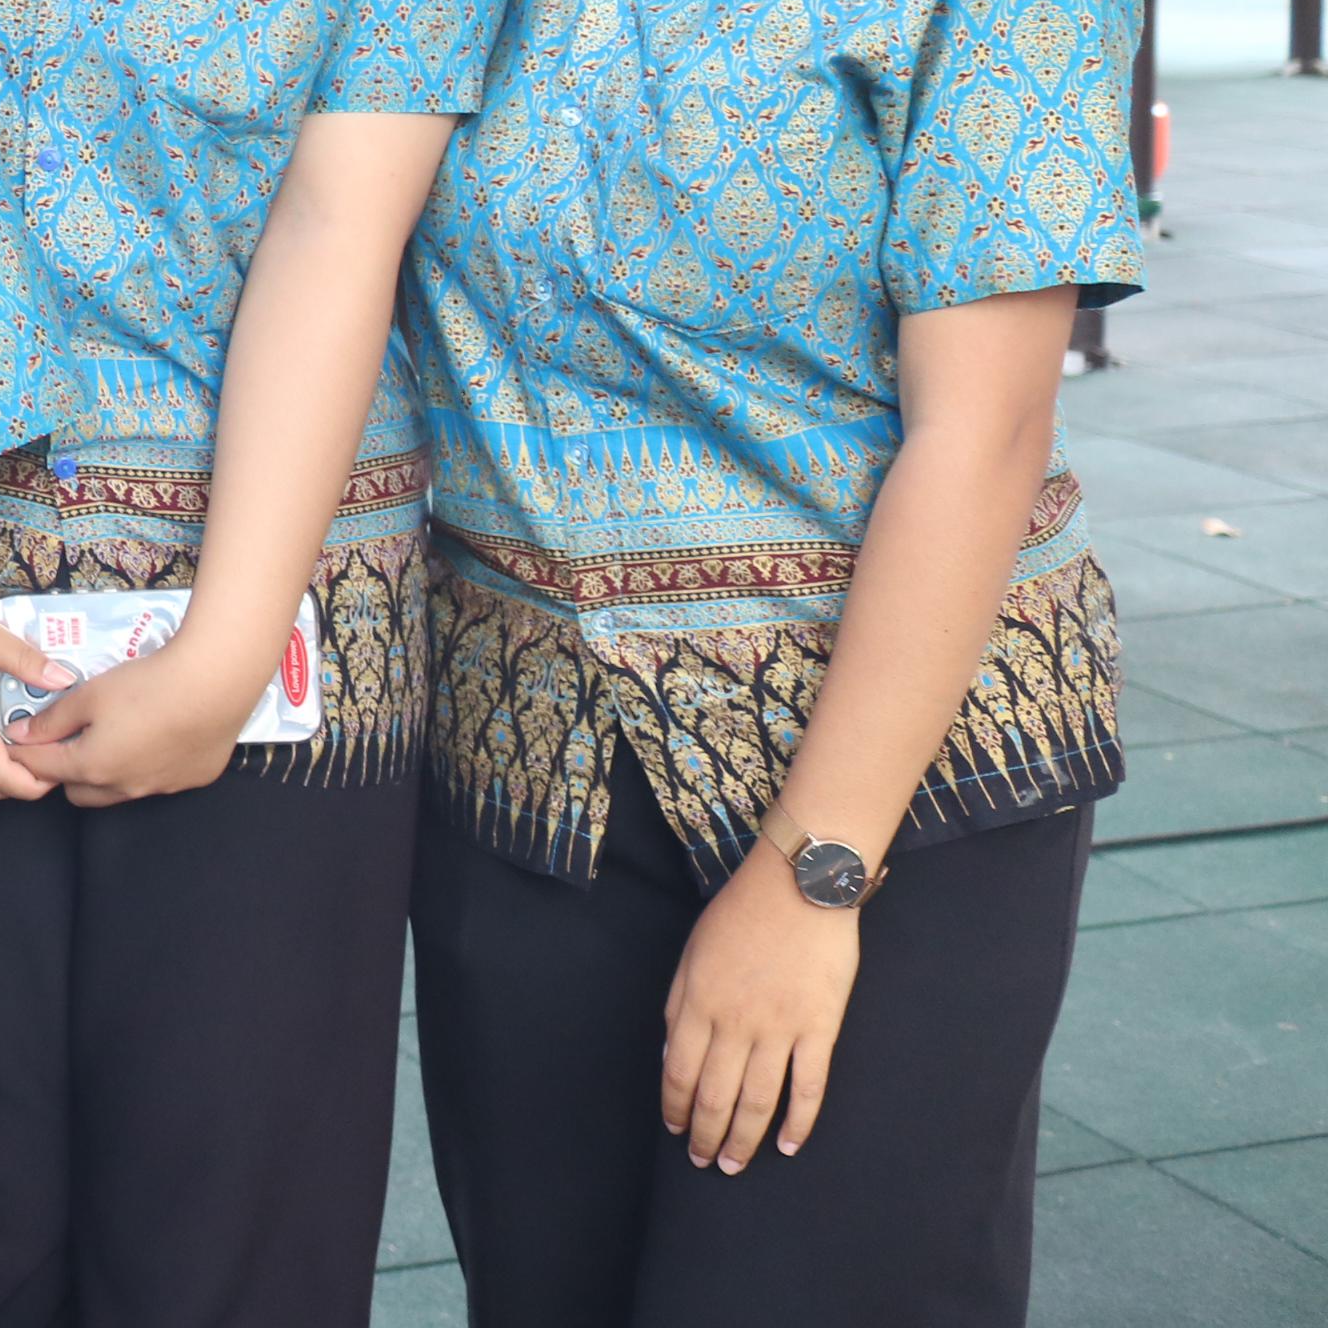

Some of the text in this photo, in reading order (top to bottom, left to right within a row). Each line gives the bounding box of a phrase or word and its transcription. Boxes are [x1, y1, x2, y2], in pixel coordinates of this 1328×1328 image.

[56, 618, 66, 645] PLAY
[126, 612, 152, 658] ennis
[289, 640, 301, 693] Lovely power
